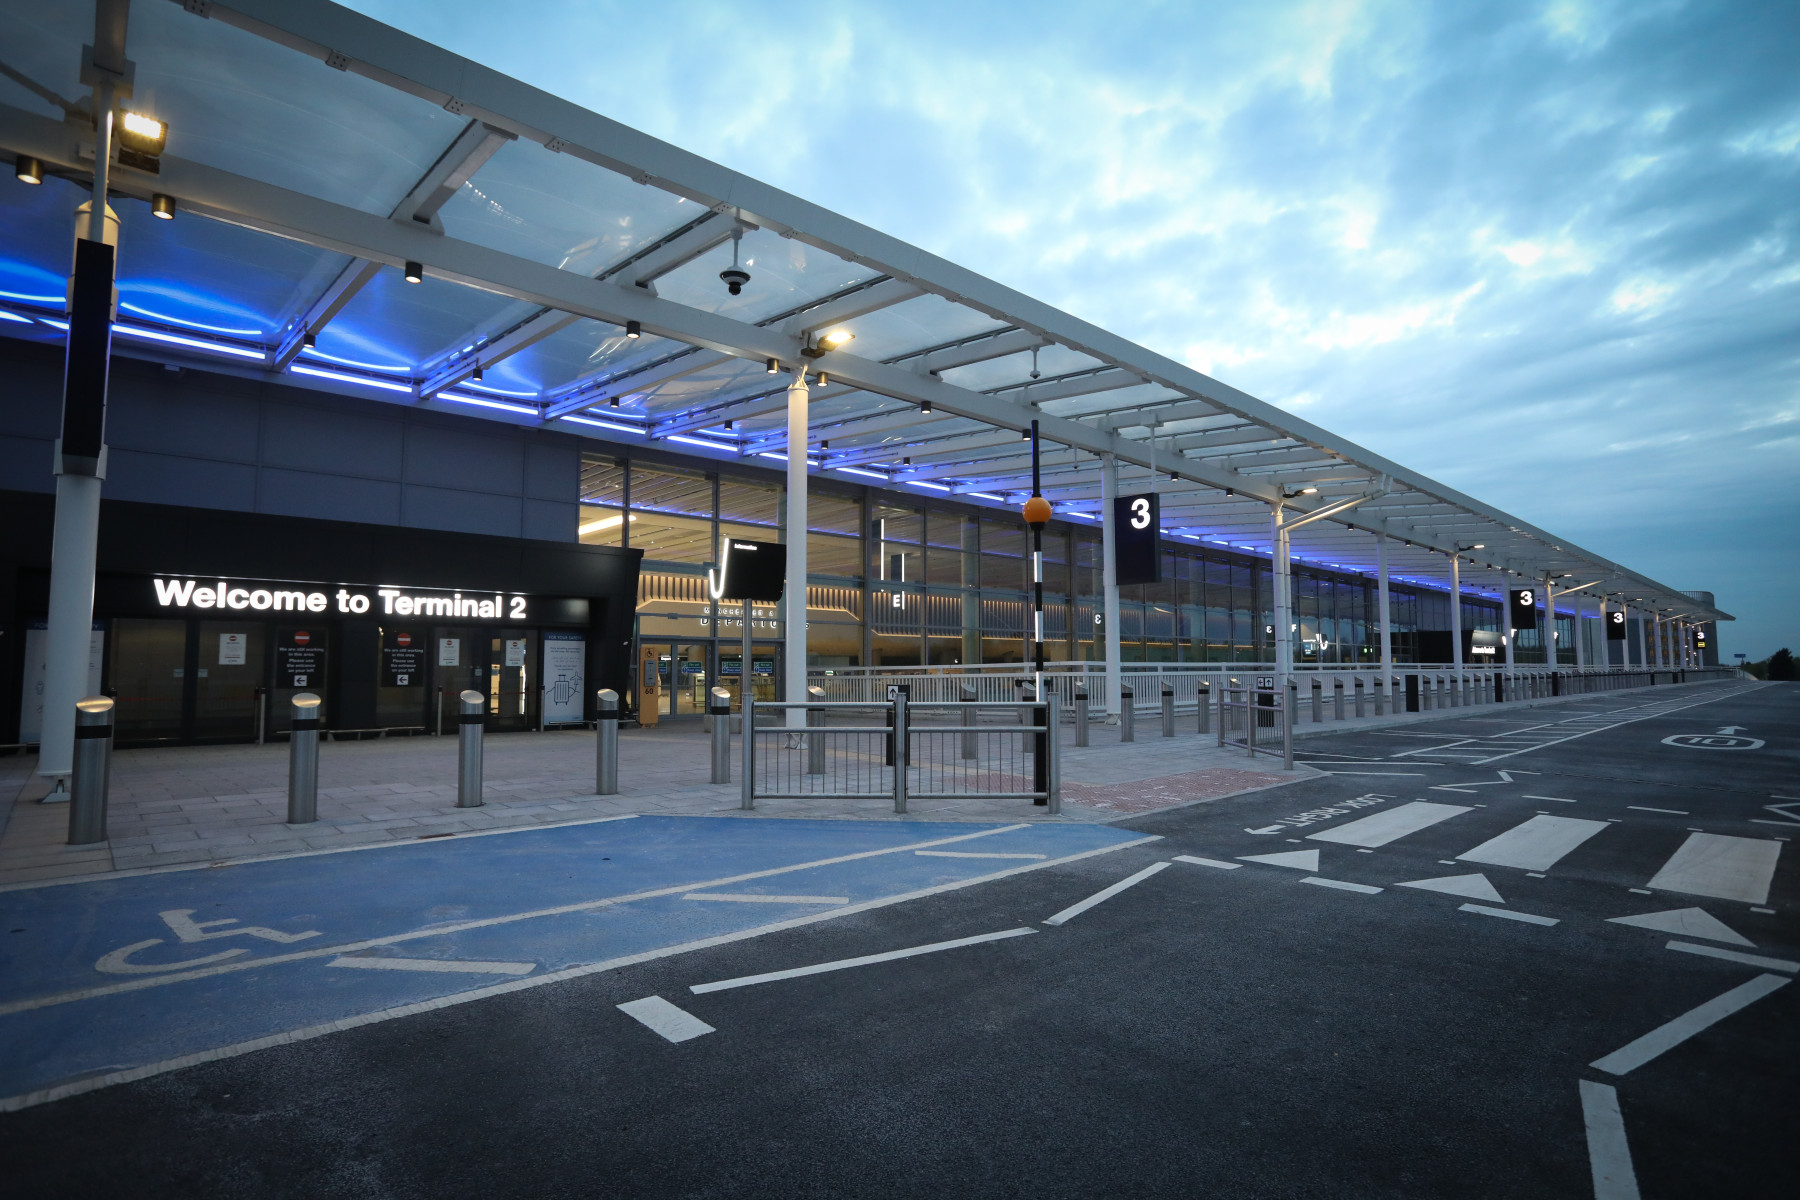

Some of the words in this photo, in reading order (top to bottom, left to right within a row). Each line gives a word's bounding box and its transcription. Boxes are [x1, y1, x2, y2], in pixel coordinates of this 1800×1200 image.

[1130, 498, 1151, 529] 3
[153, 578, 328, 612] Welcome
[336, 589, 370, 614] to
[378, 590, 502, 618] Terminal
[509, 597, 526, 619] 2
[1520, 590, 1533, 606] 3
[1613, 612, 1624, 624] 3
[1697, 631, 1705, 640] 3
[1275, 806, 1352, 827] RIGHT
